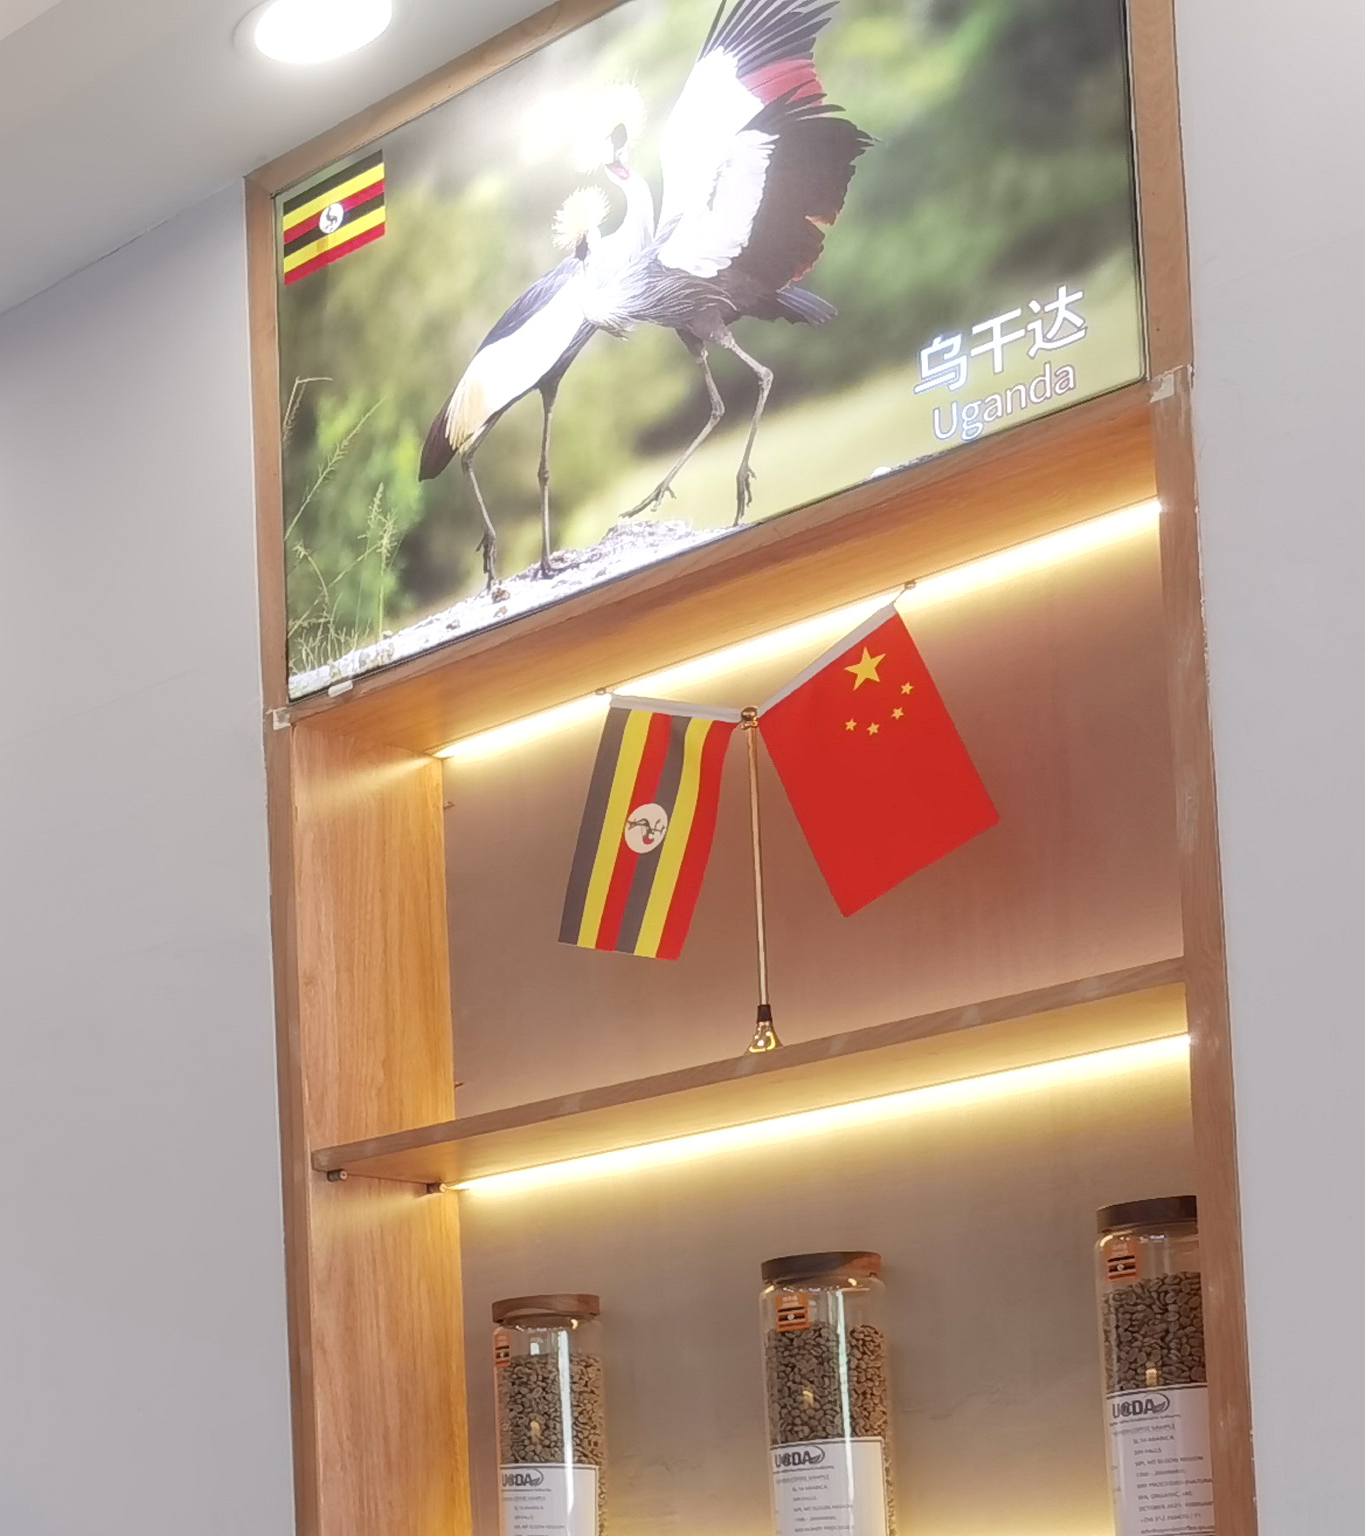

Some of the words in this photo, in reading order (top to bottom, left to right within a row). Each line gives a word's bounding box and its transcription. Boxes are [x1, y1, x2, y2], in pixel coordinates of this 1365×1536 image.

[913, 285, 1088, 395] 乌干达
[933, 361, 1077, 442] Uganda
